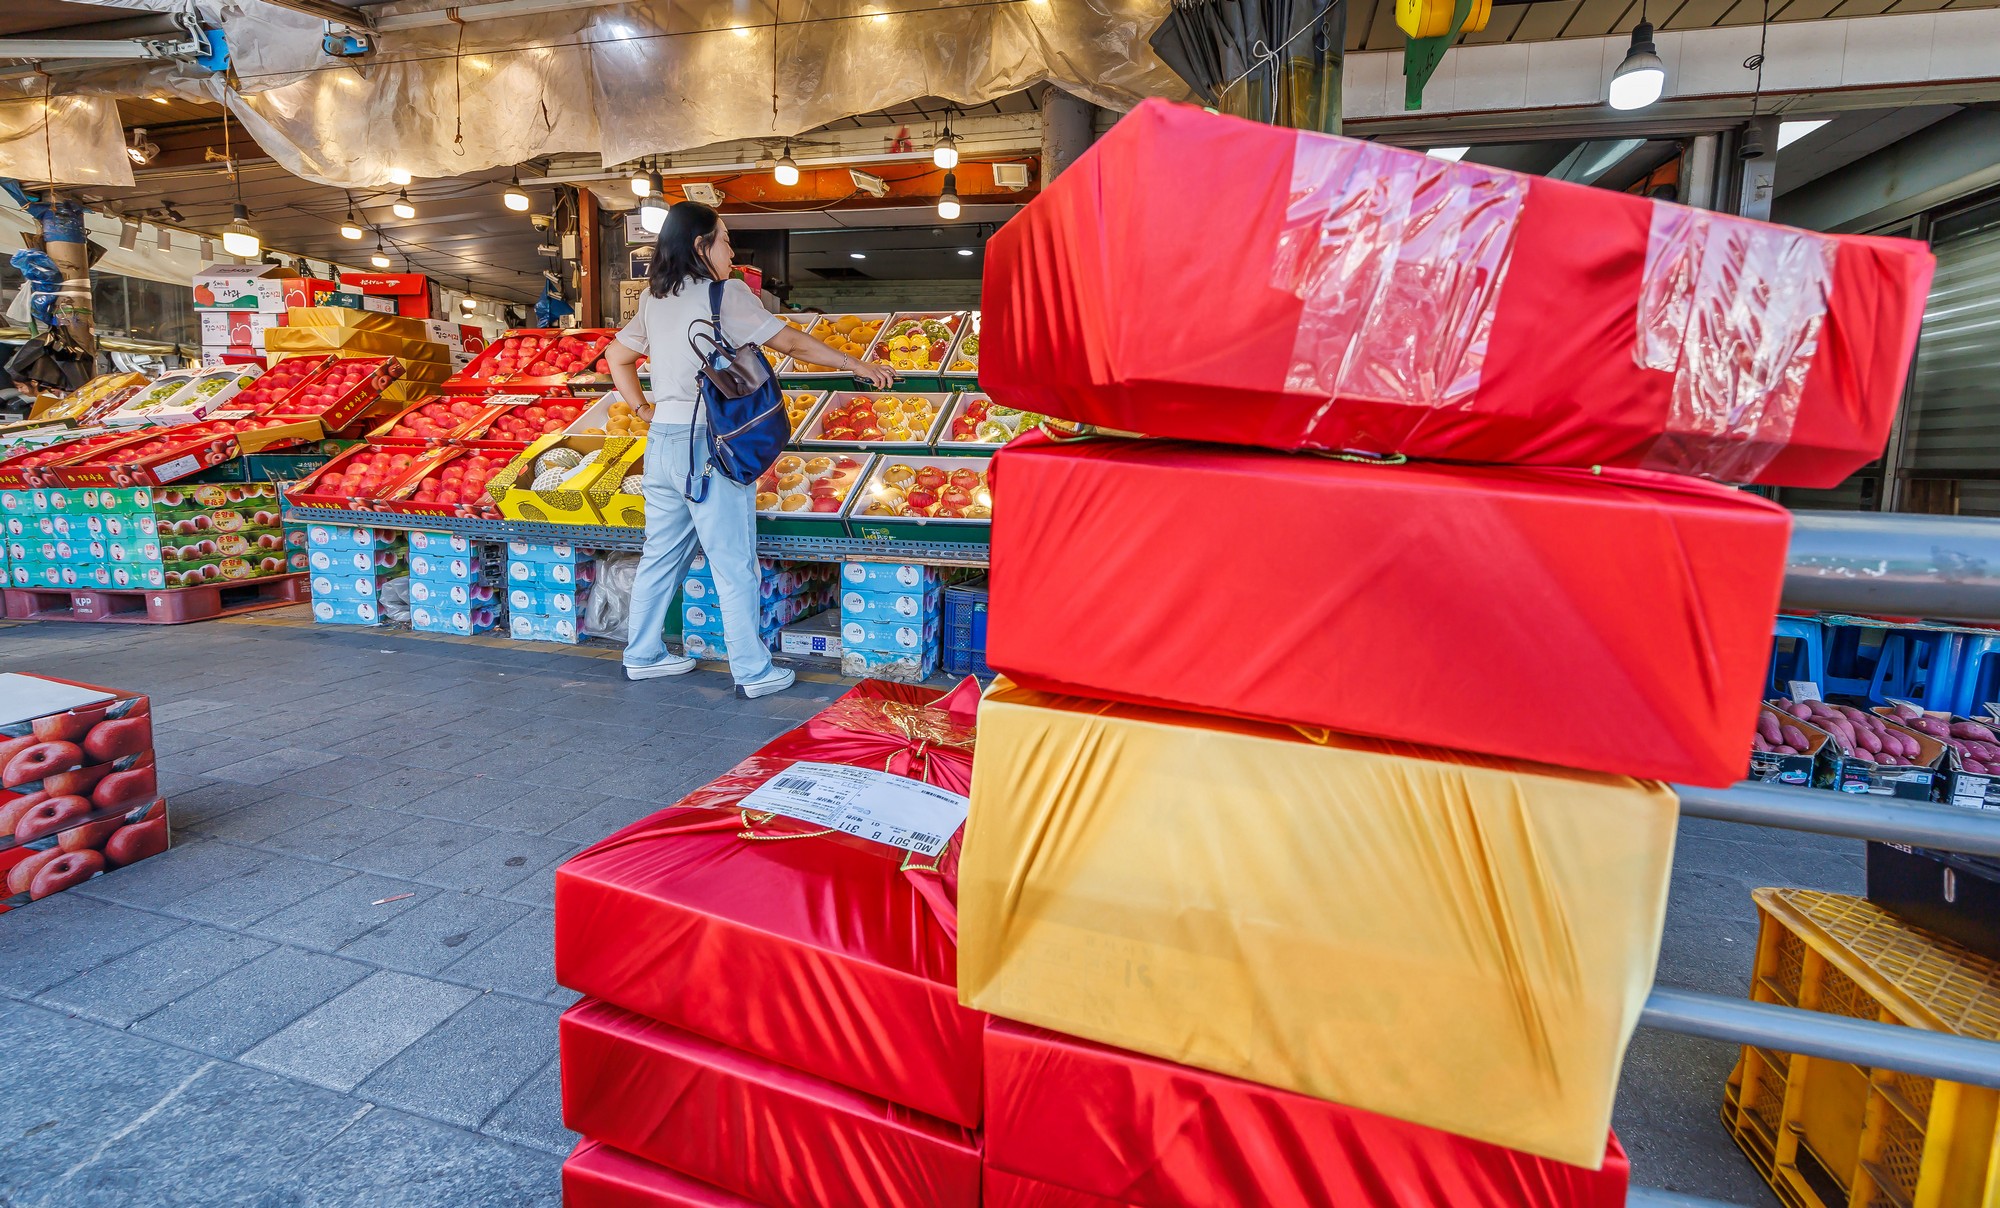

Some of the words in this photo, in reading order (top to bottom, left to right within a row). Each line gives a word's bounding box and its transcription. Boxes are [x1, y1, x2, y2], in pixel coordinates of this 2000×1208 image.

[223, 289, 240, 299] 사과
[75, 597, 92, 607] KPP
[839, 821, 860, 833] 311
[888, 835, 911, 848] 501
[914, 841, 933, 853] MD
